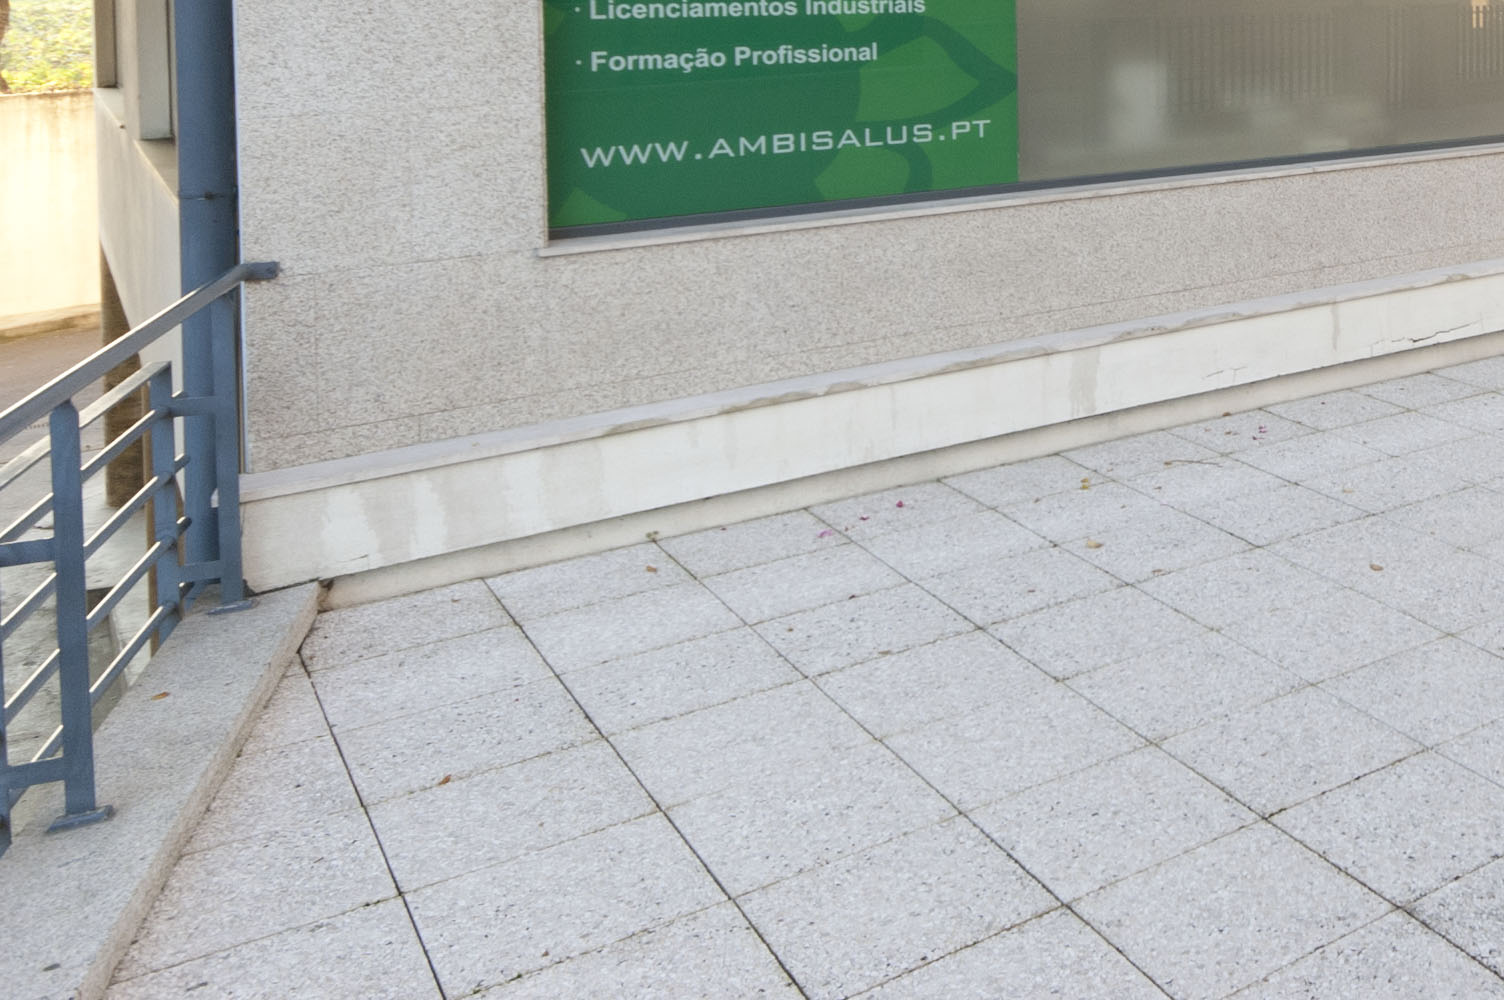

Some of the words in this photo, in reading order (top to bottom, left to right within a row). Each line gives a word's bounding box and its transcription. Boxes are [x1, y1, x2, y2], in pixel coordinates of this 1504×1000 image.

[591, 48, 726, 73] Formação
[734, 43, 878, 66] Profissional
[581, 120, 991, 169] WWW.AMBISALUS.PT
